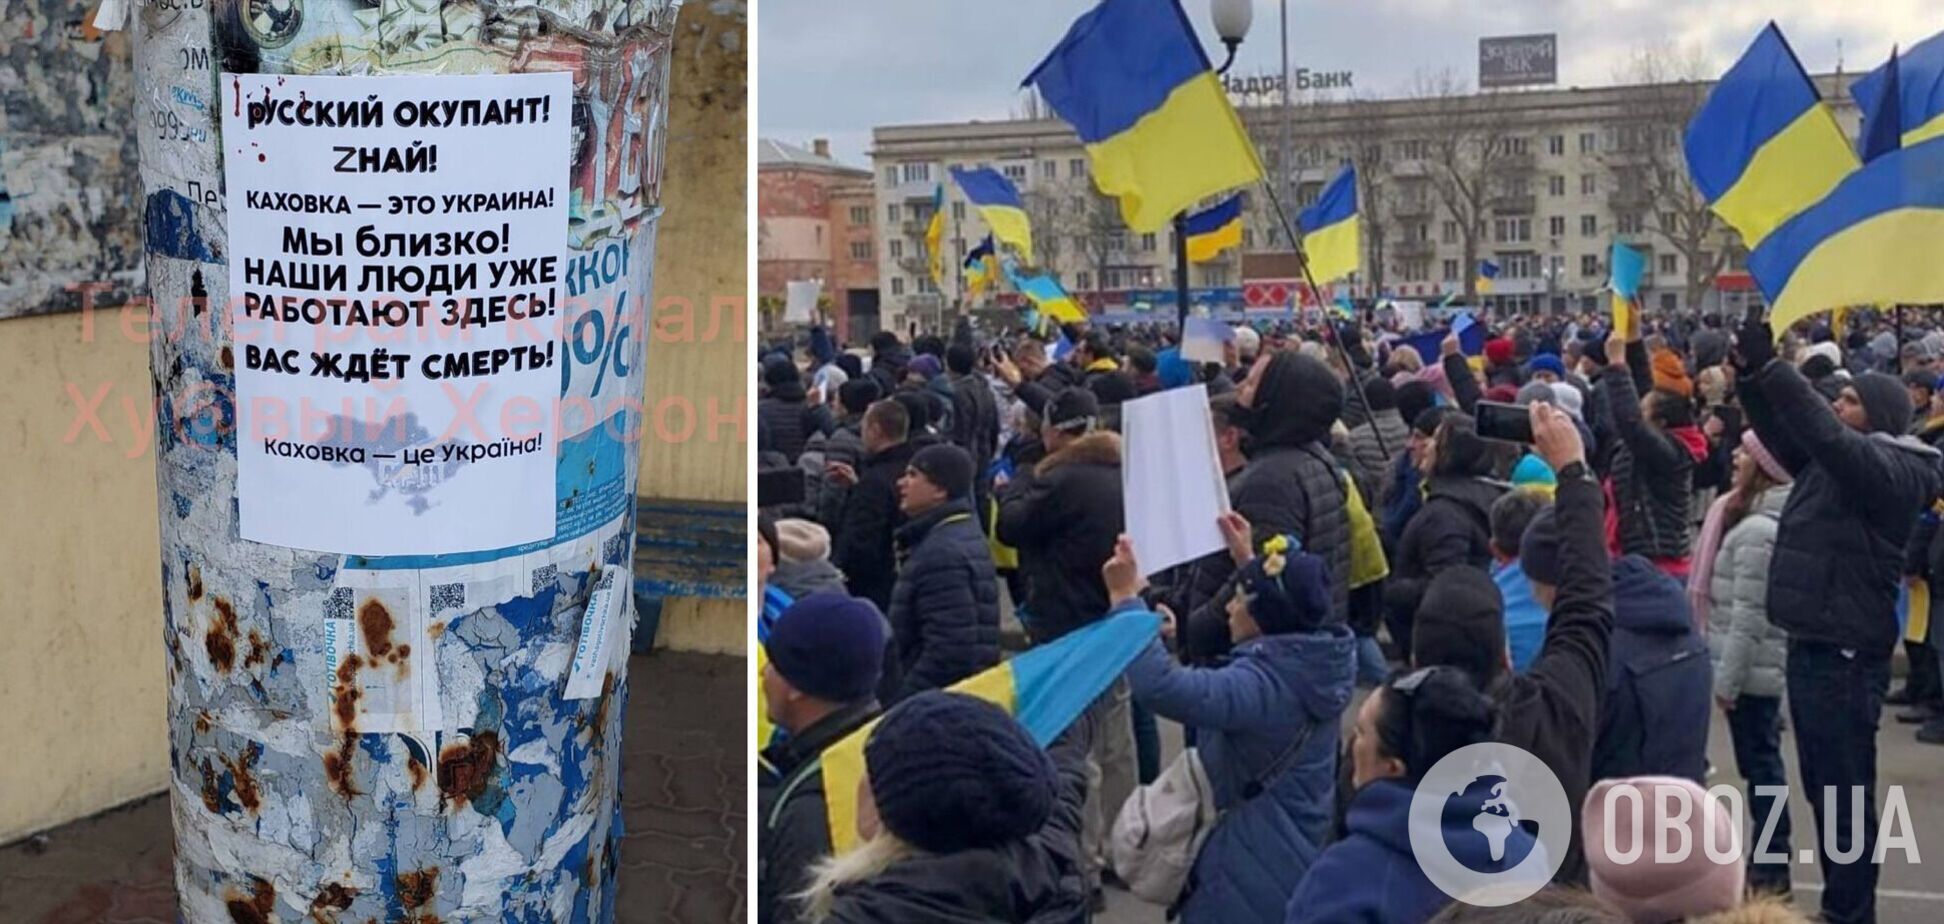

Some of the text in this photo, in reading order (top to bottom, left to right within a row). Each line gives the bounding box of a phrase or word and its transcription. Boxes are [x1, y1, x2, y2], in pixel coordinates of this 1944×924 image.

[1295, 67, 1353, 91] Банк
[392, 94, 550, 128] ОКУПАНТ!
[246, 190, 352, 214] КАХОВКА
[388, 195, 436, 215] ЭТО
[442, 187, 554, 214] УКРАИНА!
[281, 222, 510, 257] Мы близко!
[244, 256, 557, 297] НАШИ ЛЮДИ УЖЕ
[244, 287, 556, 329] РАБОТАЮТ ЗДЕСЬ!
[245, 340, 554, 383] ВАС ЖДЁТ СМЕРТЬ!
[264, 438, 366, 464] Каховка
[403, 447, 436, 466] це
[441, 432, 543, 465] Україна!
